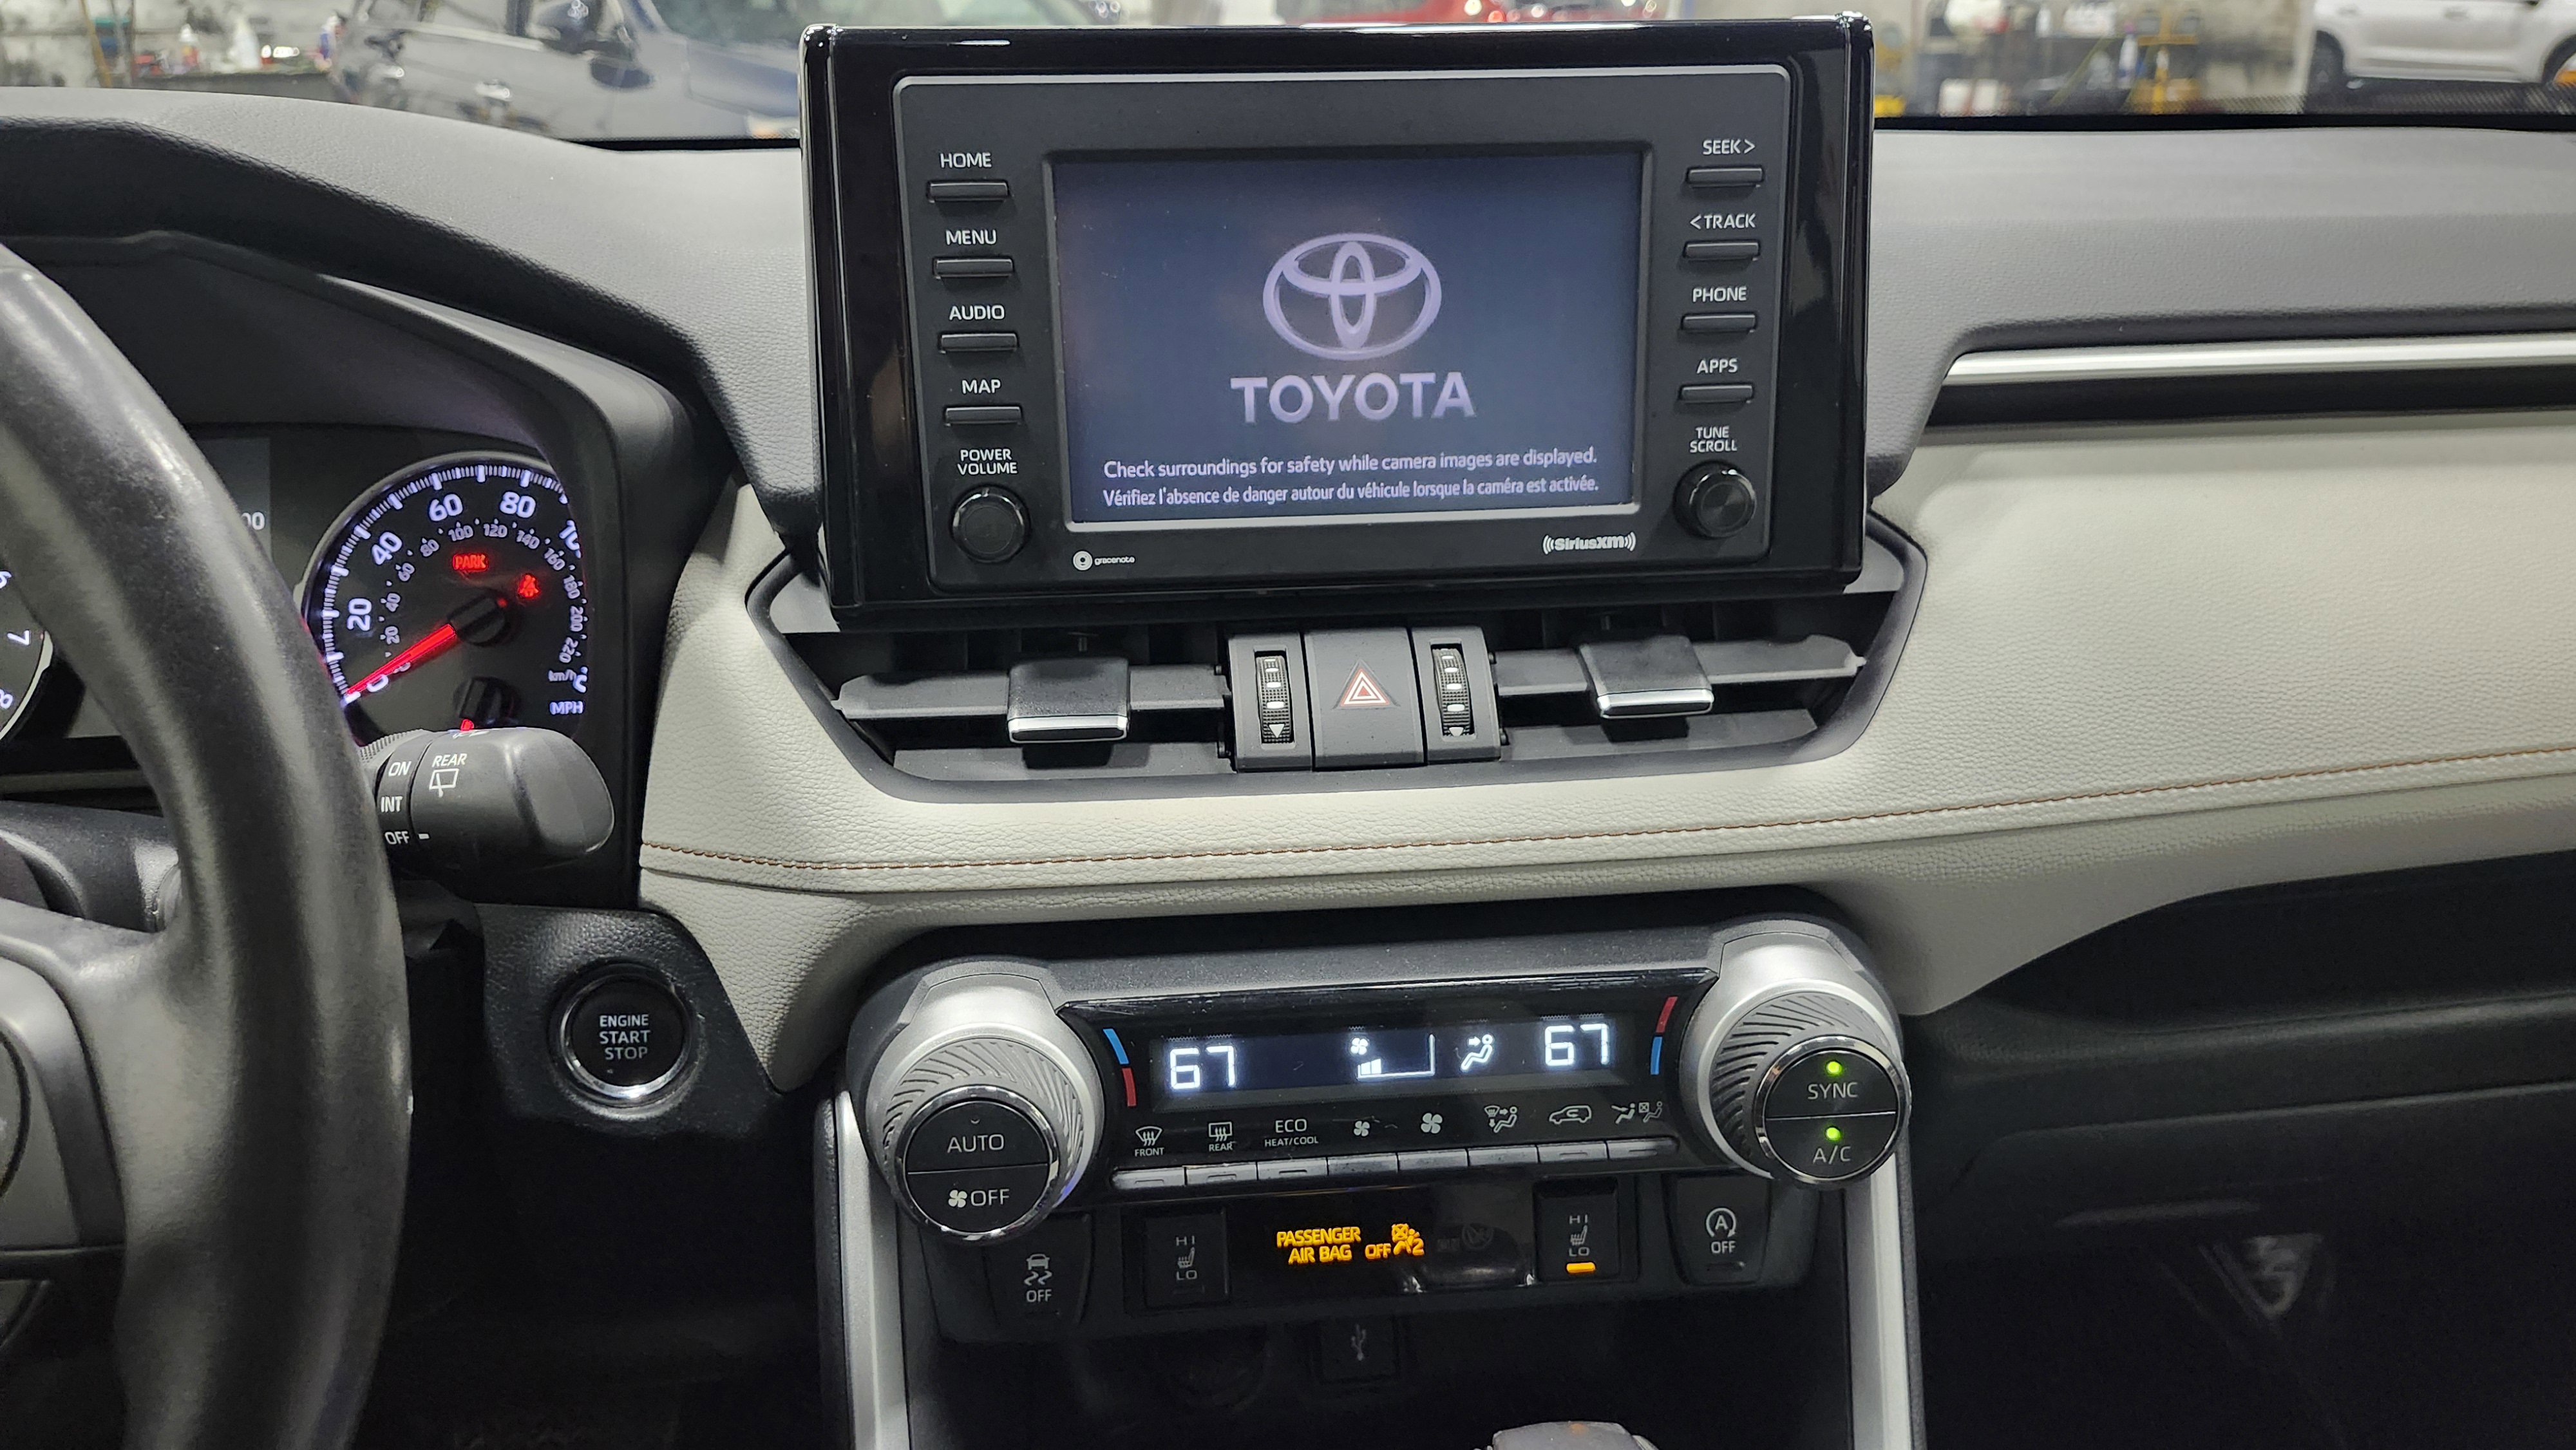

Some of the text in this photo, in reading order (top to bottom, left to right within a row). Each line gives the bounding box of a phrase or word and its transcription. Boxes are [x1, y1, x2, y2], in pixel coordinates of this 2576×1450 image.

[940, 152, 992, 168] HOME
[946, 229, 997, 245] MENU
[1692, 286, 1747, 303] PHONE
[949, 305, 1005, 321] AUDIO
[1696, 358, 1738, 374] APPS
[961, 379, 1001, 395] MAP
[1230, 372, 1476, 424] TOYOTA
[1695, 425, 1730, 439] TUNE
[1689, 438, 1738, 453] SCROLL
[960, 448, 1012, 462] POWER
[1103, 446, 1598, 479] Check surroundings for safety while camera images are displayed.
[957, 462, 1018, 475] VOLUME
[1103, 473, 1599, 507] Vérifiez l'absence de danger autour du véhicule lorsque la caméra est activée.
[429, 493, 463, 522] 60
[499, 491, 536, 518] 80
[448, 524, 474, 541] 100
[483, 523, 508, 538] 120
[516, 529, 540, 550] 140
[371, 531, 402, 565] 40
[420, 539, 440, 557] 80
[454, 554, 486, 570] PARK
[544, 547, 566, 571] 160
[1094, 556, 1135, 566] gracenote
[398, 562, 415, 581] 60
[564, 574, 580, 599] 180
[386, 592, 401, 612] 40
[347, 598, 372, 632] 20
[570, 605, 583, 632] 200
[7, 630, 30, 645] 7
[384, 626, 400, 645] 20
[559, 637, 578, 663] 220
[549, 701, 583, 715] MPH
[432, 753, 468, 767] REAR
[388, 760, 412, 777] ON
[381, 796, 403, 813] INT
[384, 830, 410, 845] OFF
[600, 1014, 650, 1028] ENGINE
[600, 1030, 650, 1044] START
[1544, 1022, 1610, 1067] 67
[605, 1047, 649, 1060] STOP
[1170, 1044, 1236, 1090] 67
[1807, 1082, 1859, 1100] SYNC
[1275, 1118, 1307, 1133] ECO
[947, 1134, 1005, 1153] AUTO
[1208, 1142, 1233, 1151] REAR
[1264, 1136, 1319, 1147] HEAT/COOL
[1134, 1147, 1164, 1157] FRONT
[1813, 1145, 1852, 1164] A/C
[971, 1189, 1010, 1207] OFF
[1569, 1214, 1589, 1224] HI
[1176, 1236, 1195, 1246] HI
[1276, 1226, 1361, 1248] PASSENGER
[1288, 1247, 1316, 1265] AIR
[1318, 1245, 1352, 1263] BAG
[1365, 1243, 1392, 1259] OFF
[1569, 1247, 1590, 1257] LO
[1710, 1240, 1737, 1254] OFF
[1176, 1270, 1198, 1281] LO
[1026, 1289, 1052, 1303] OFF
